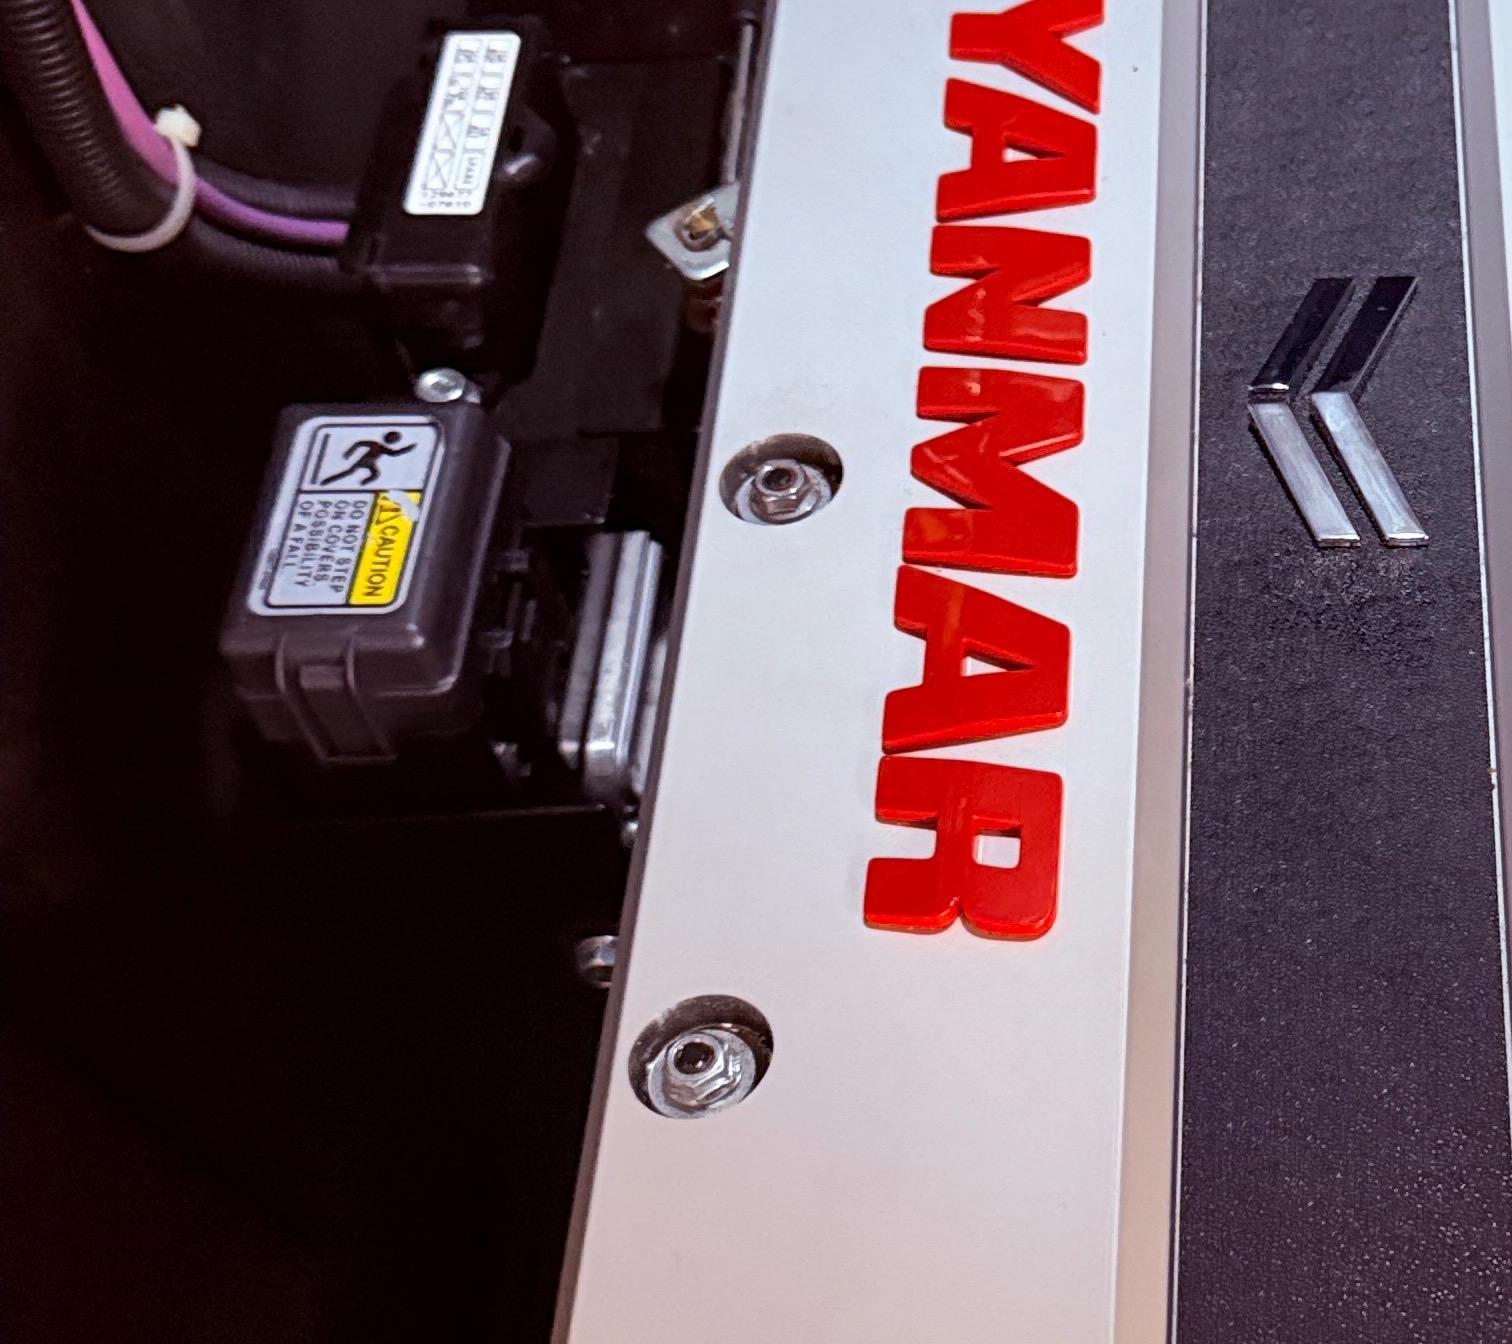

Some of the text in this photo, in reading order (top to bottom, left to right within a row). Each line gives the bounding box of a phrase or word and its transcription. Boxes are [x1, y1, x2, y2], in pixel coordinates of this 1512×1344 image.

[292, 524, 308, 532] A
[296, 501, 315, 517] OF
[331, 500, 351, 519] ON
[292, 501, 333, 587] POSSIBILITY
[327, 500, 368, 592] DO NOT STEP
[361, 525, 400, 597] CAUTION
